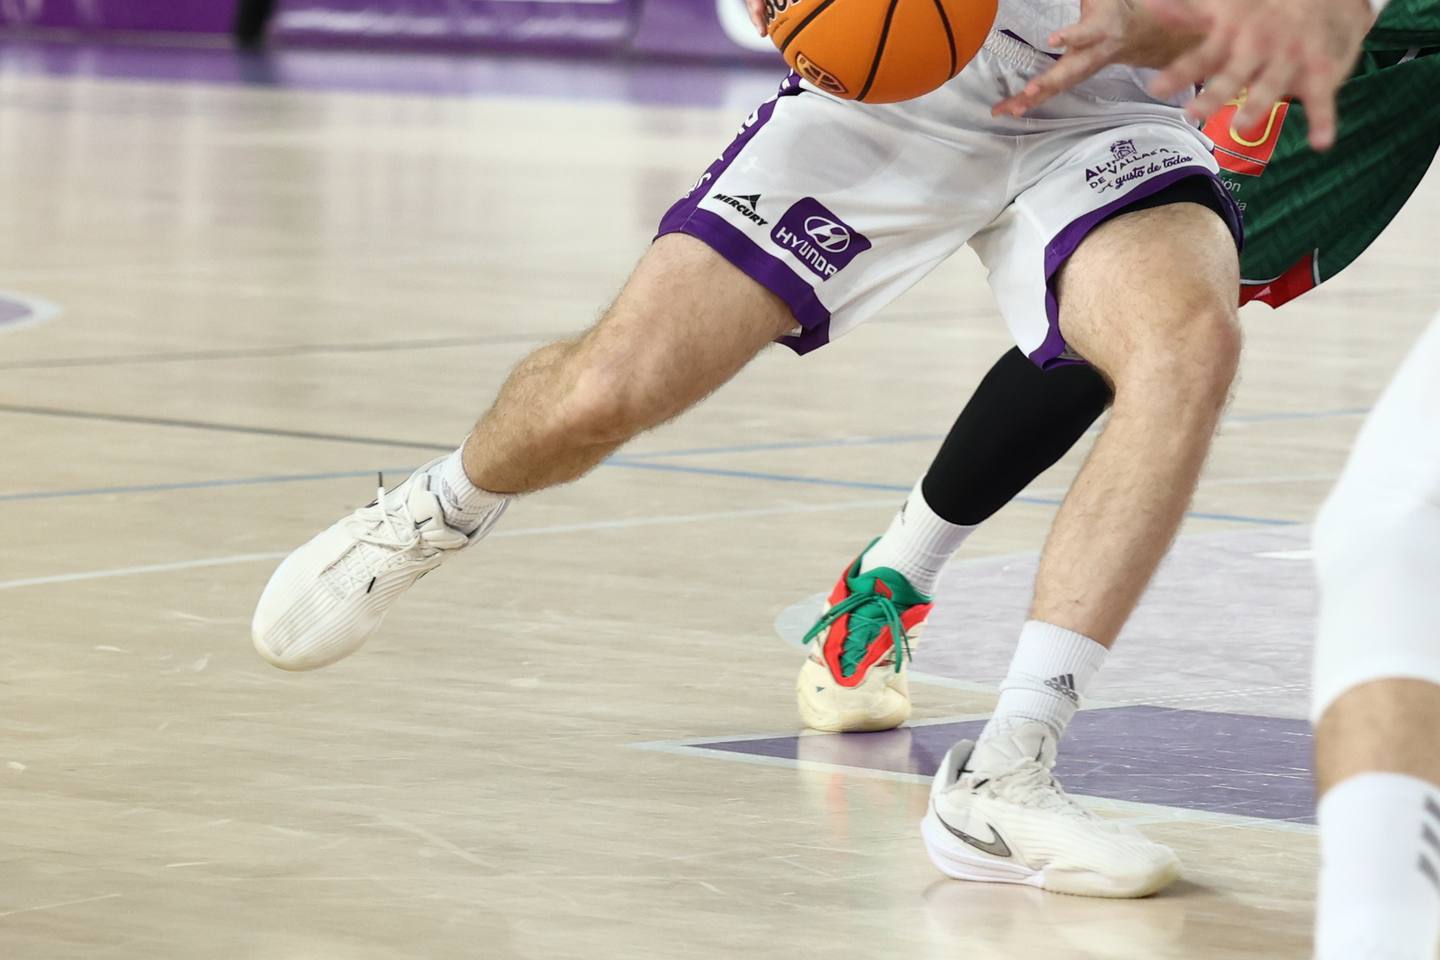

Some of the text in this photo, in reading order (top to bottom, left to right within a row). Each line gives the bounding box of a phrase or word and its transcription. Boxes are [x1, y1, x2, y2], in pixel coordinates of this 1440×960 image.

[1089, 176, 1107, 189] DE
[1114, 165, 1146, 191] gusto
[1146, 162, 1162, 175] de
[1161, 154, 1194, 169] todos
[712, 193, 769, 228] MERCURY
[775, 226, 839, 277] HYUNDA
